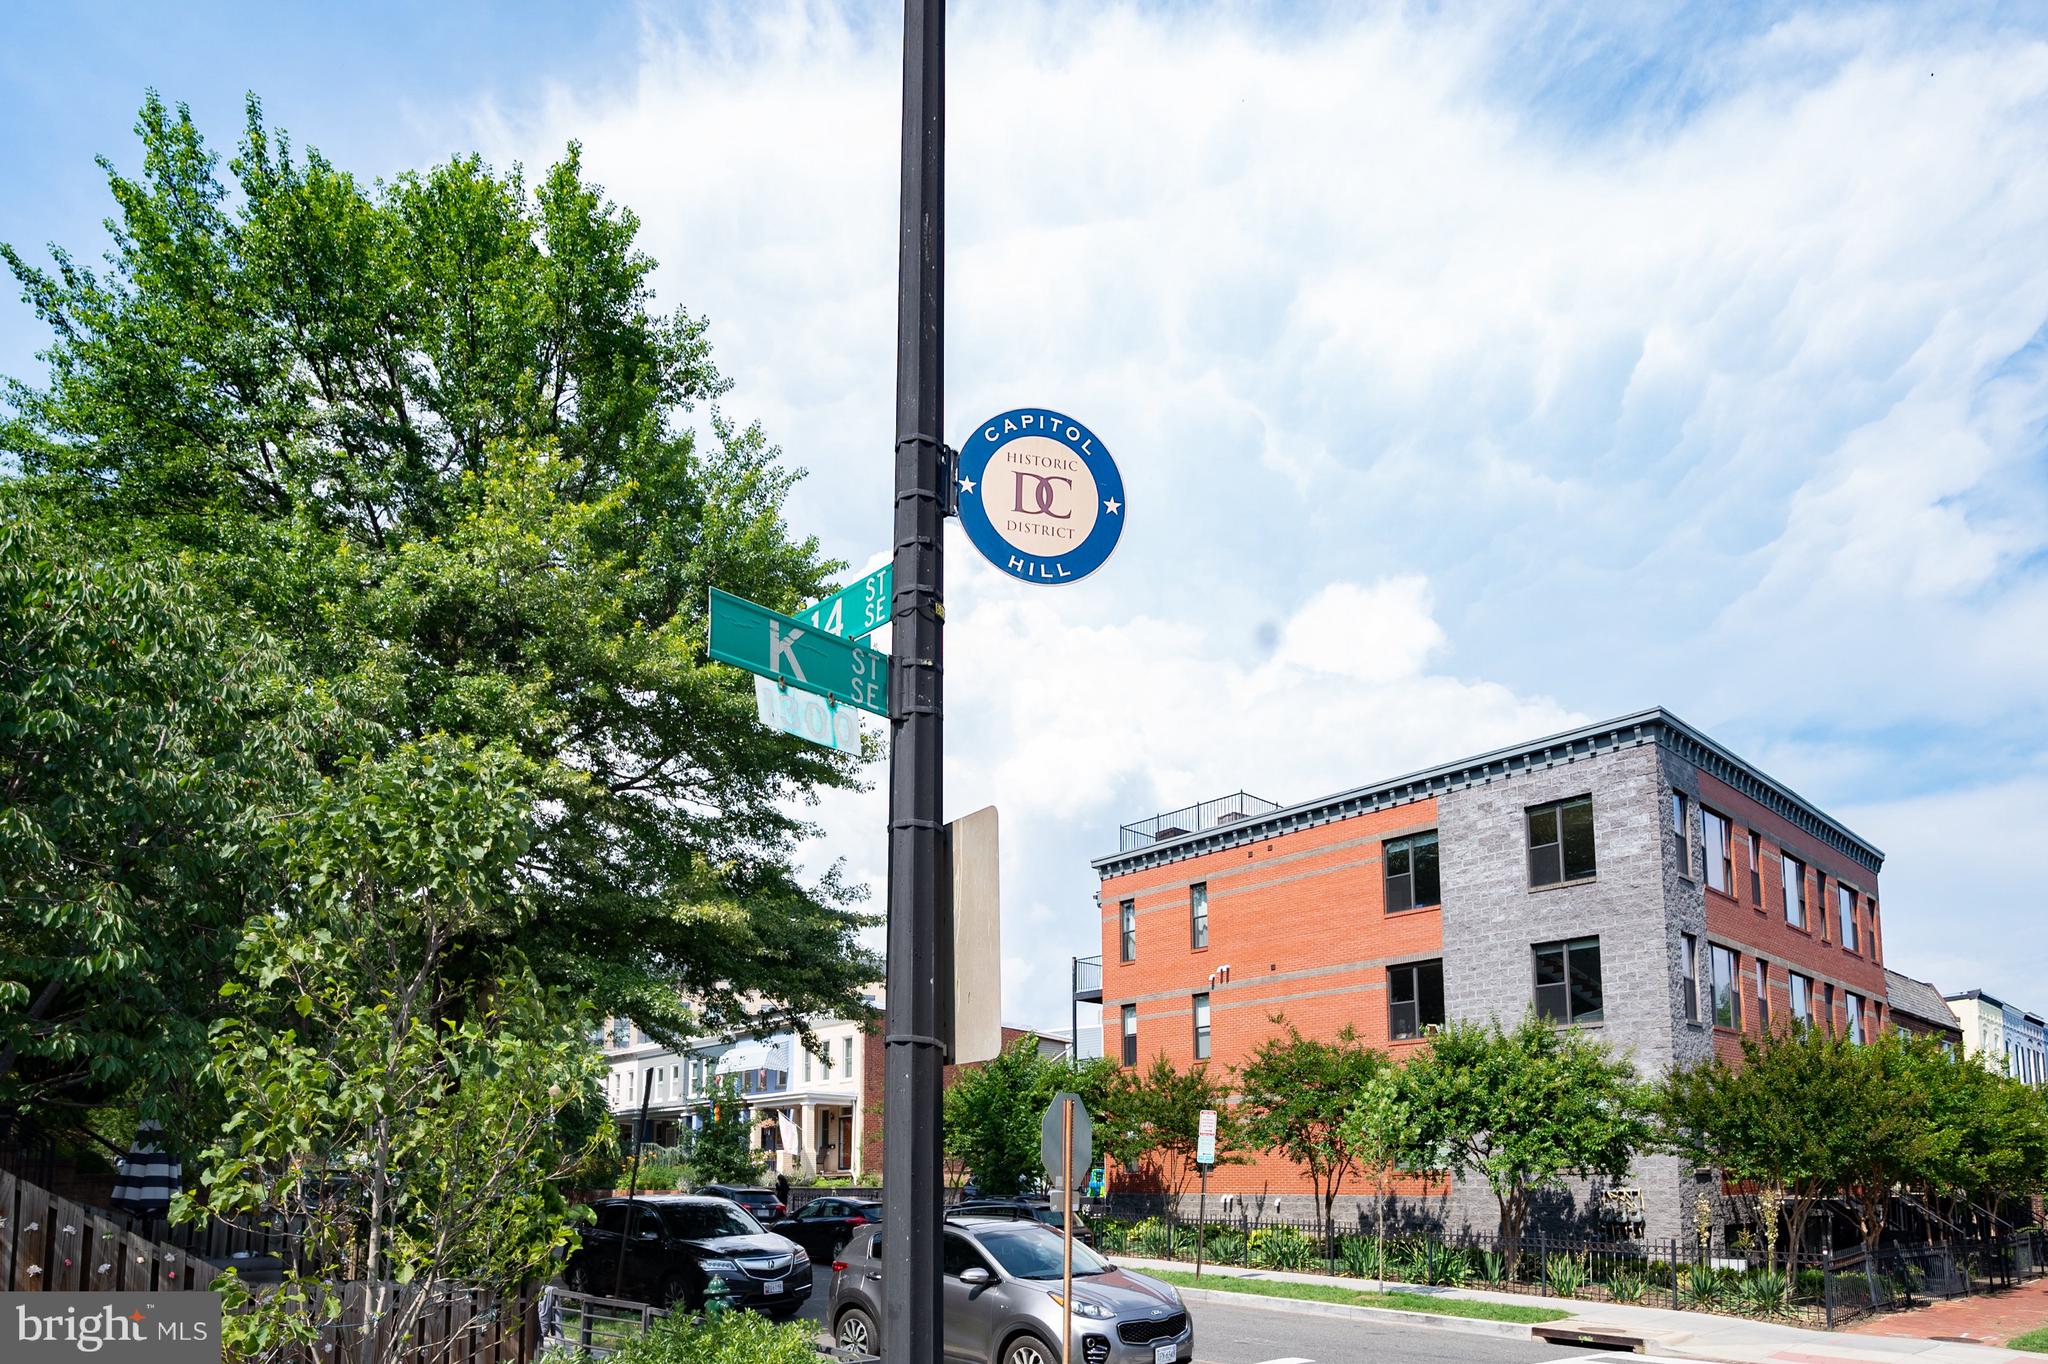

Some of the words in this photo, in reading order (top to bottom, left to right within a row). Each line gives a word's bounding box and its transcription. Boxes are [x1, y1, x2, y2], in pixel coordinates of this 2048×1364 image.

[984, 415, 1093, 456] CAPITOL
[1006, 452, 1078, 472] HISTORIC
[1011, 471, 1073, 520] DC
[1006, 520, 1076, 540] DISTRICT
[1008, 555, 1071, 578] HILL
[865, 570, 887, 602] ST
[864, 596, 886, 628] SE
[769, 619, 808, 683] K
[851, 647, 880, 681] ST
[851, 678, 880, 710] SE
